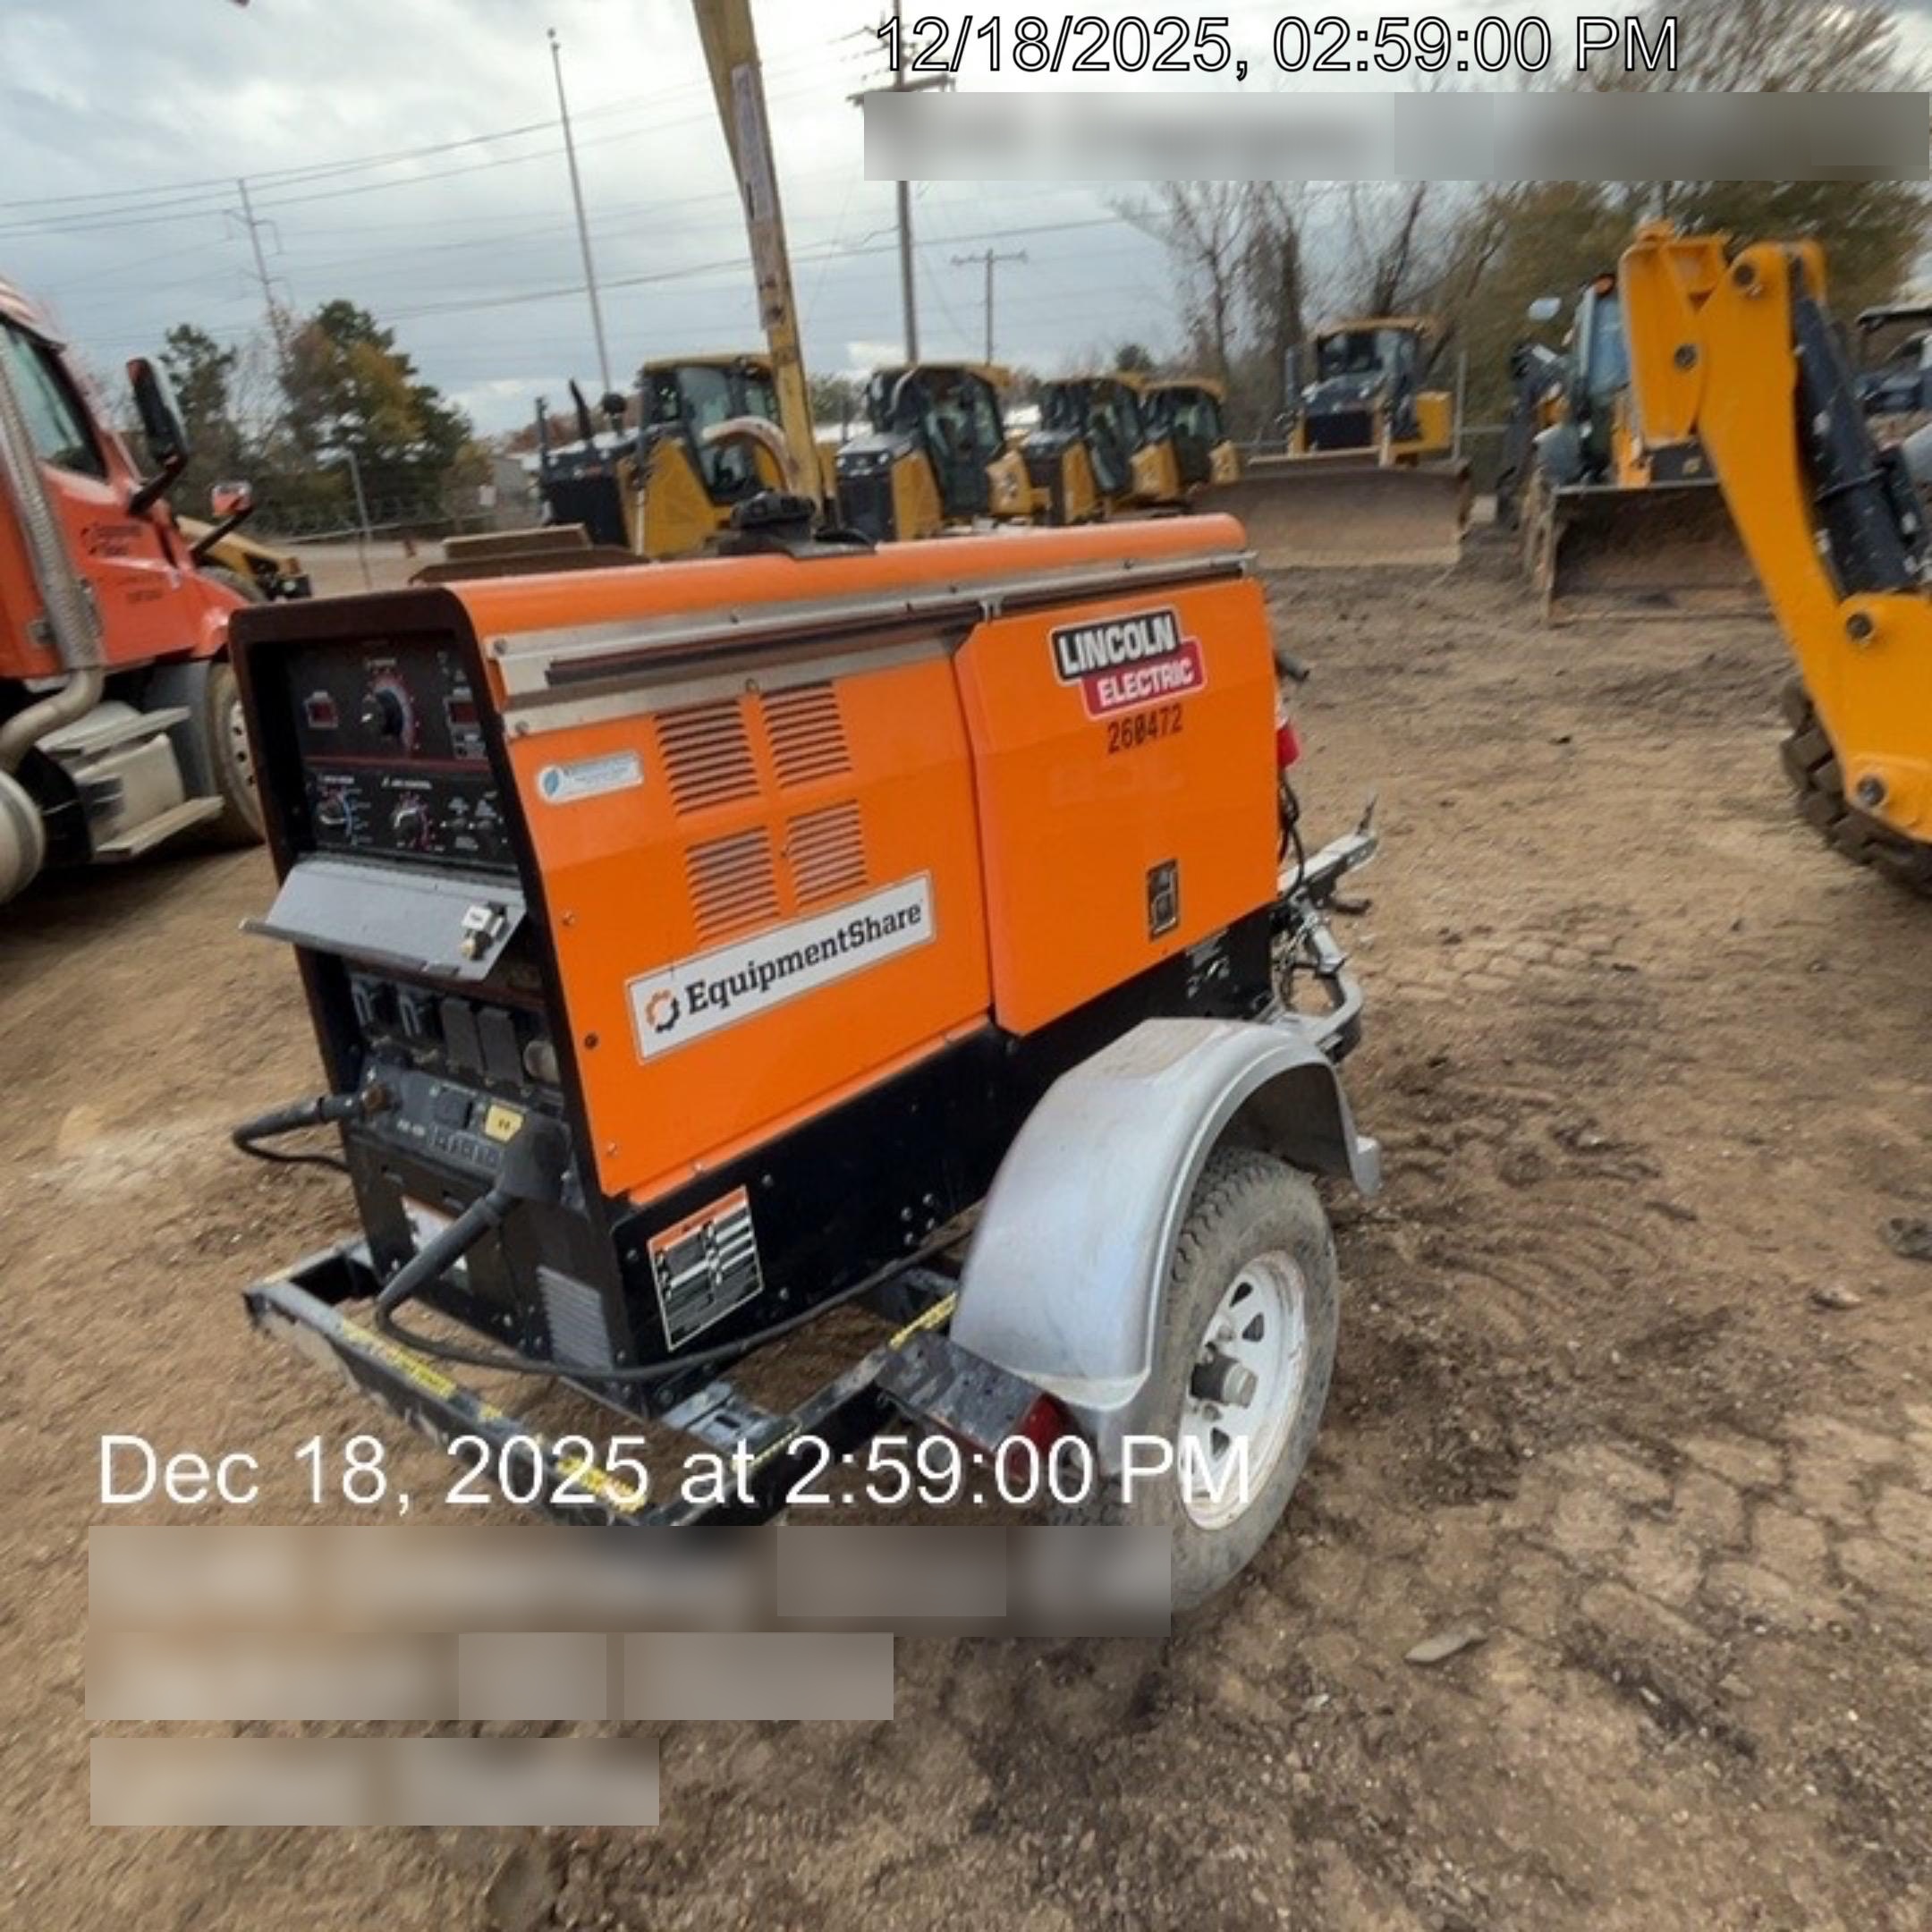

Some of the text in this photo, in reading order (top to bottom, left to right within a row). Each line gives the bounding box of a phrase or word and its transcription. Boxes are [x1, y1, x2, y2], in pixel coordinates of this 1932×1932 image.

[1058, 614, 1177, 674] LINCOLN
[1097, 657, 1194, 707] ELECTRIC
[685, 902, 921, 1014] EquipmentShare
